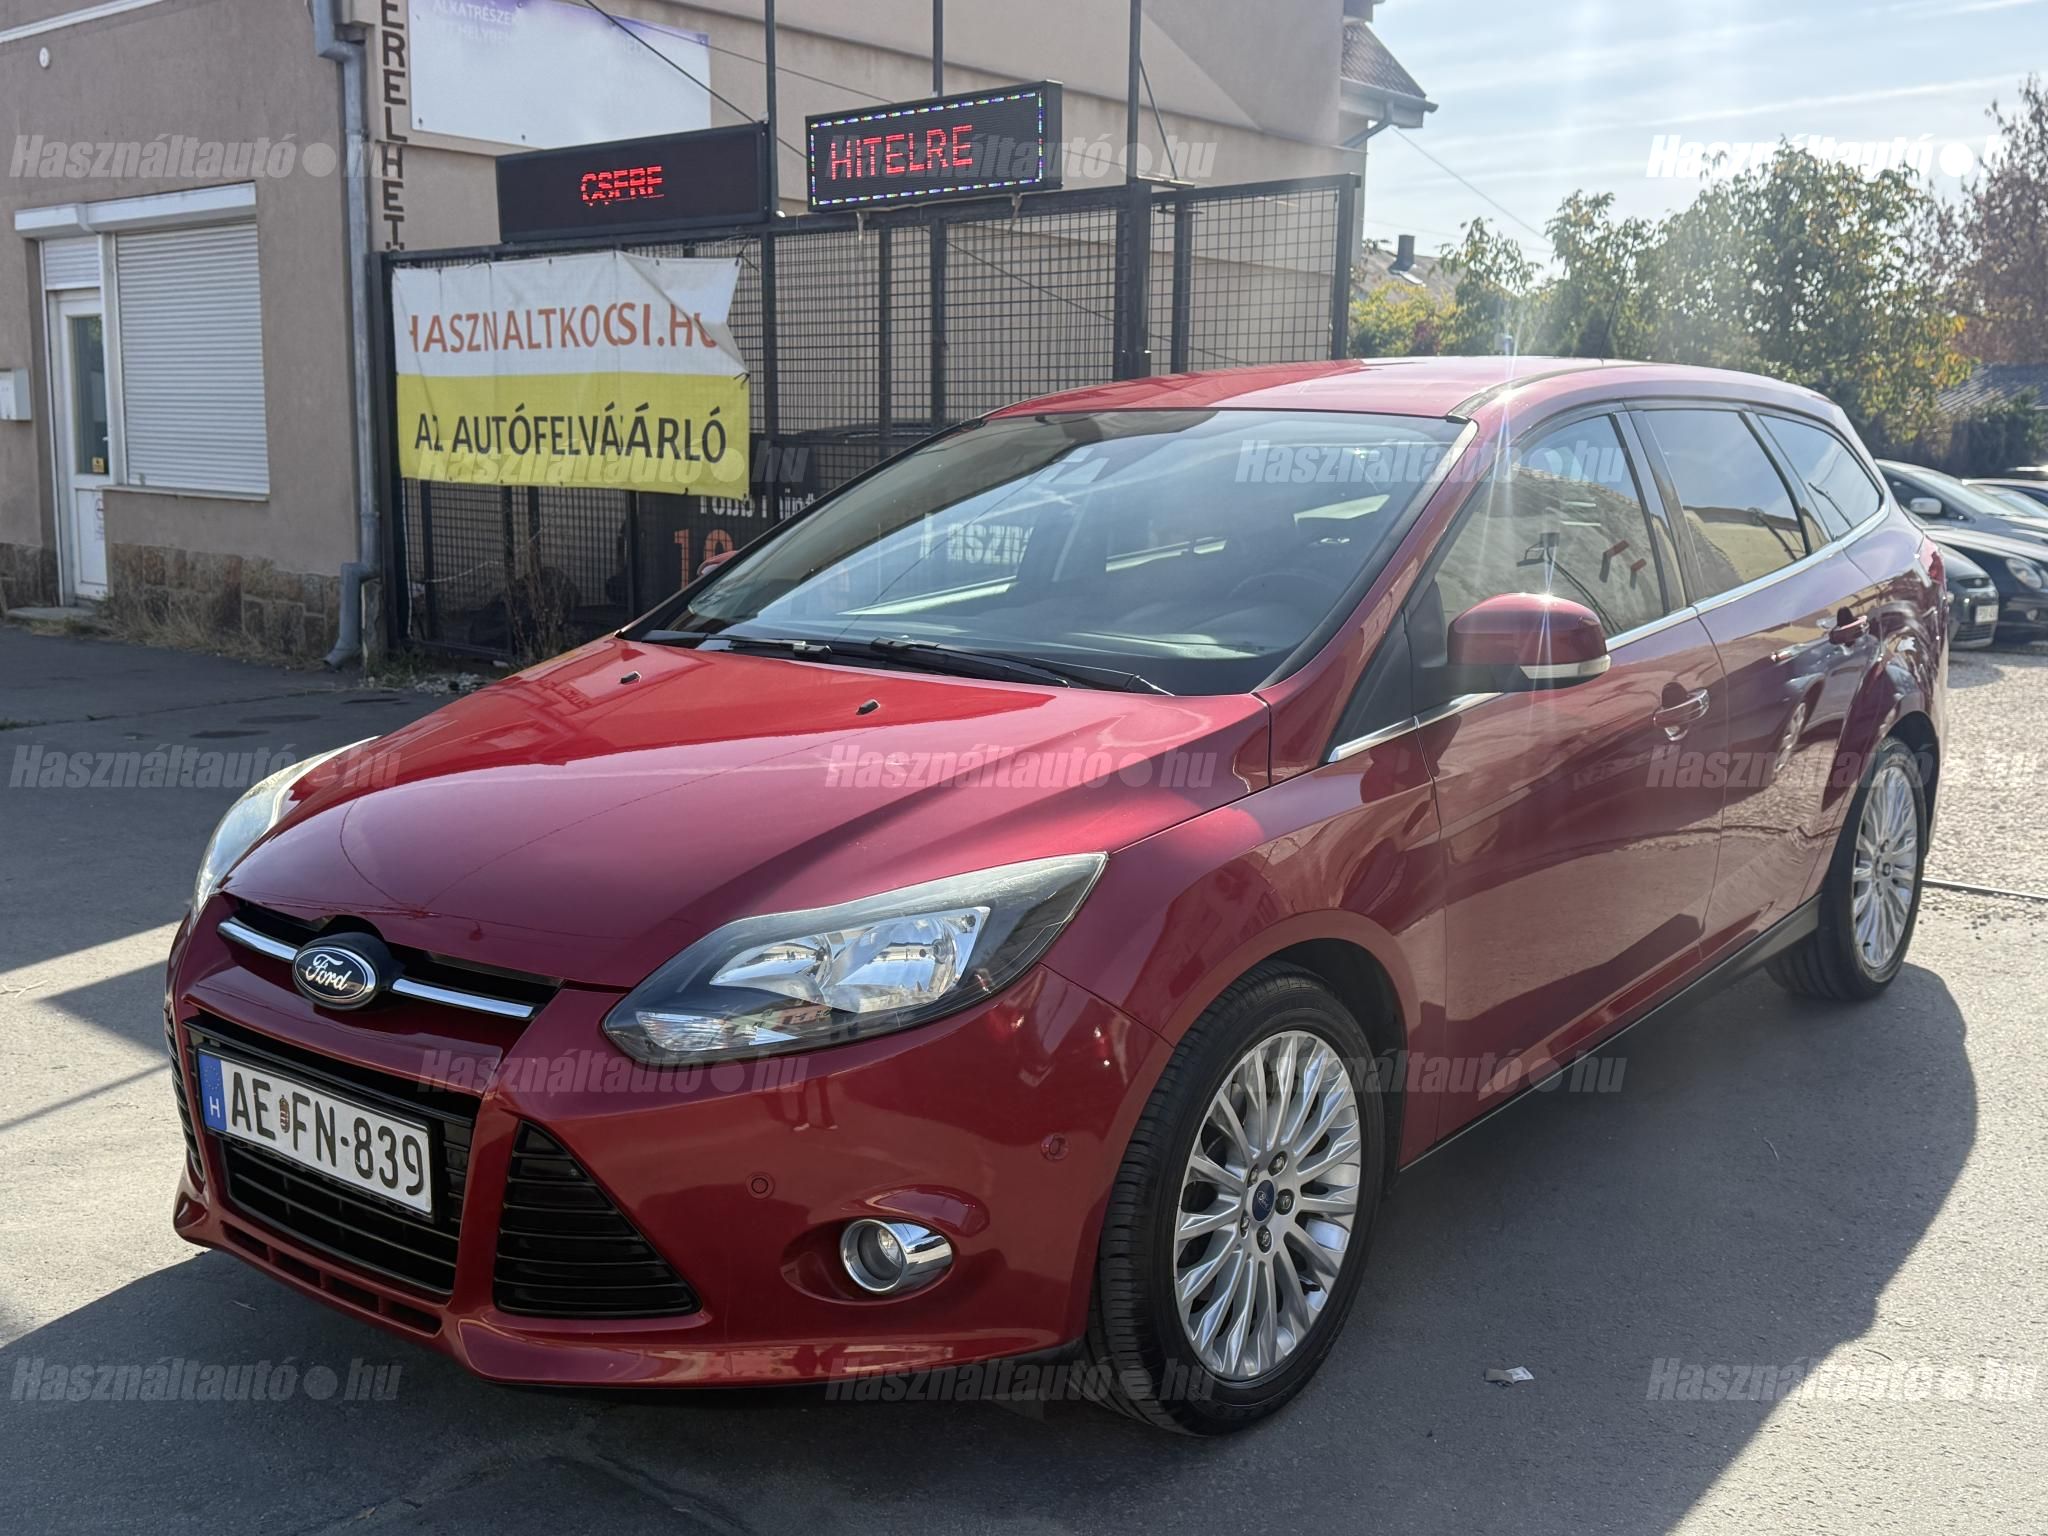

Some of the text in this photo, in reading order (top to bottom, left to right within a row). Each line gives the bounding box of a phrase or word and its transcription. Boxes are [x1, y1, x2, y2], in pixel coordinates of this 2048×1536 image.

[831, 124, 973, 180] HITELRE
[304, 953, 353, 991] Ford
[209, 1096, 221, 1119] H
